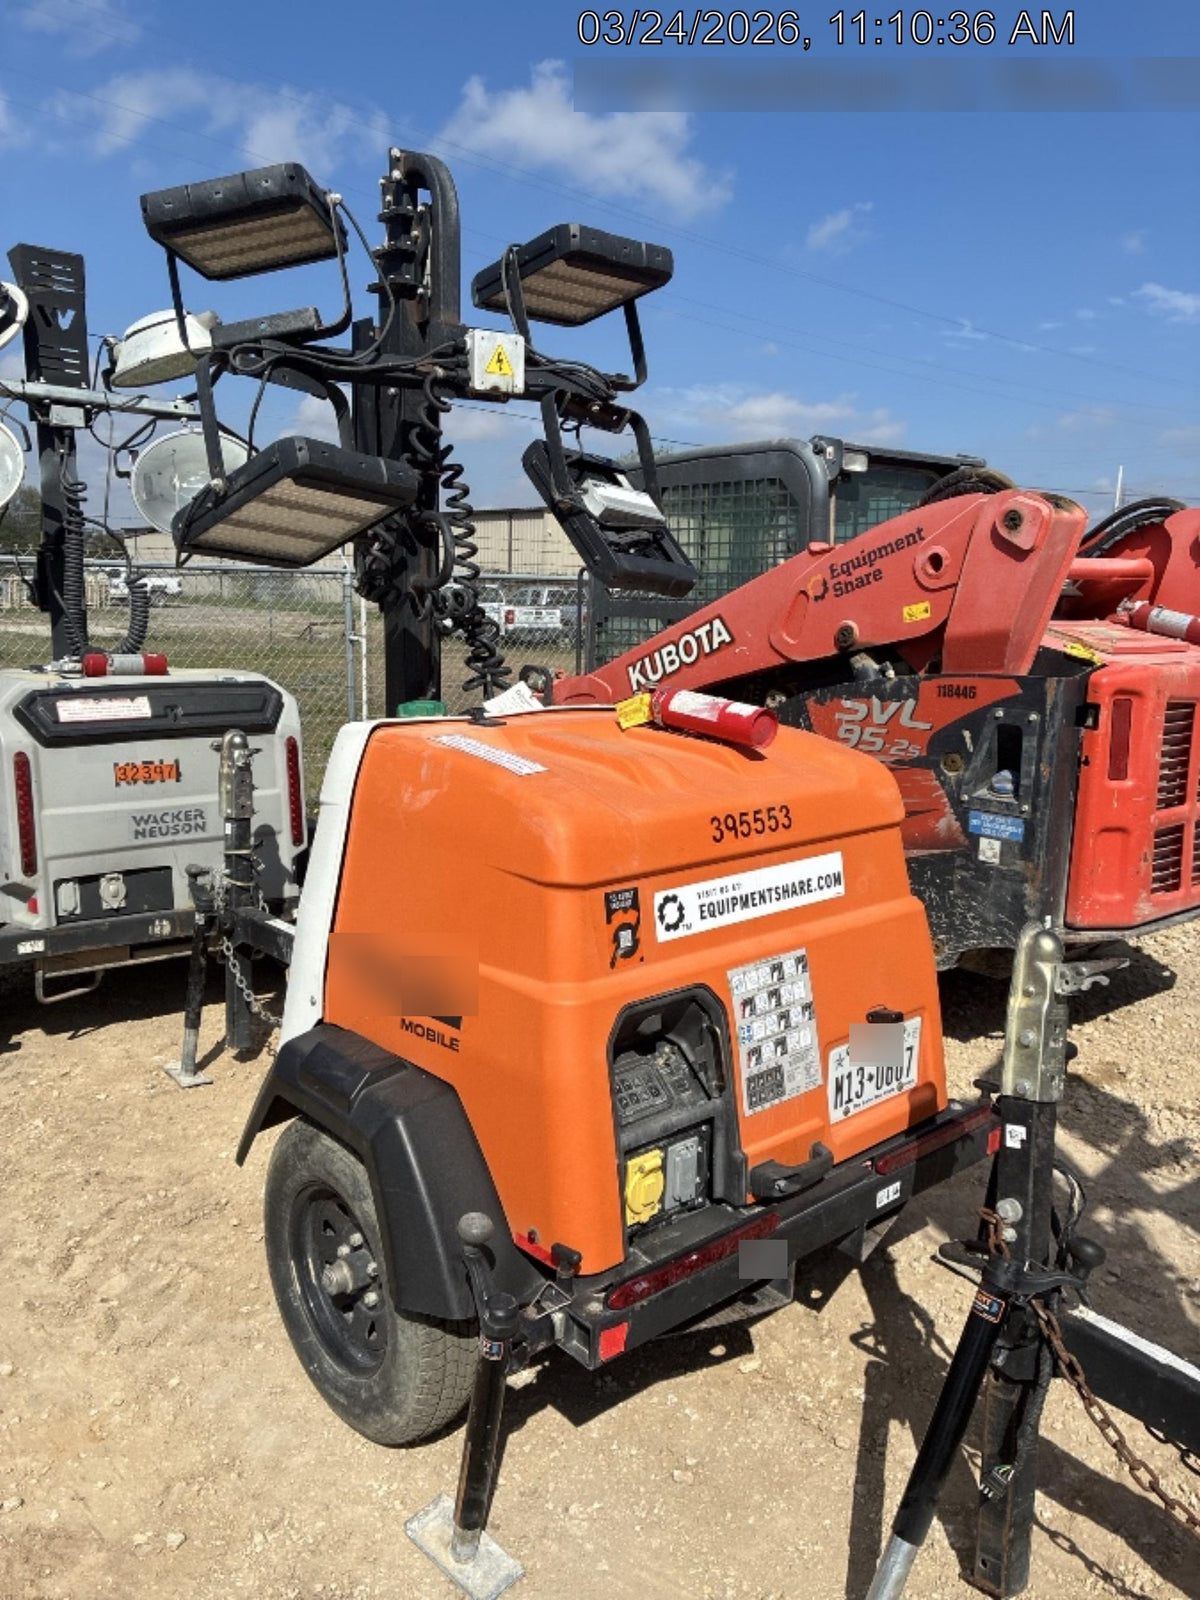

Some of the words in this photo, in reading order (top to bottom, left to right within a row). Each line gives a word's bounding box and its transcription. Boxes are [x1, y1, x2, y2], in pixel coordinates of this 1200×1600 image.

[829, 526, 926, 580] Equipment
[832, 568, 884, 598] Share
[626, 615, 733, 692] KUBOTA
[935, 683, 977, 699] 118446
[835, 694, 934, 730] SVL
[131, 808, 206, 828] WACKER
[133, 821, 208, 840] NEUSON
[710, 804, 793, 843] 395553
[698, 870, 843, 921] EQUIPMENTSHARE.COM
[400, 1017, 461, 1053] MOBILE
